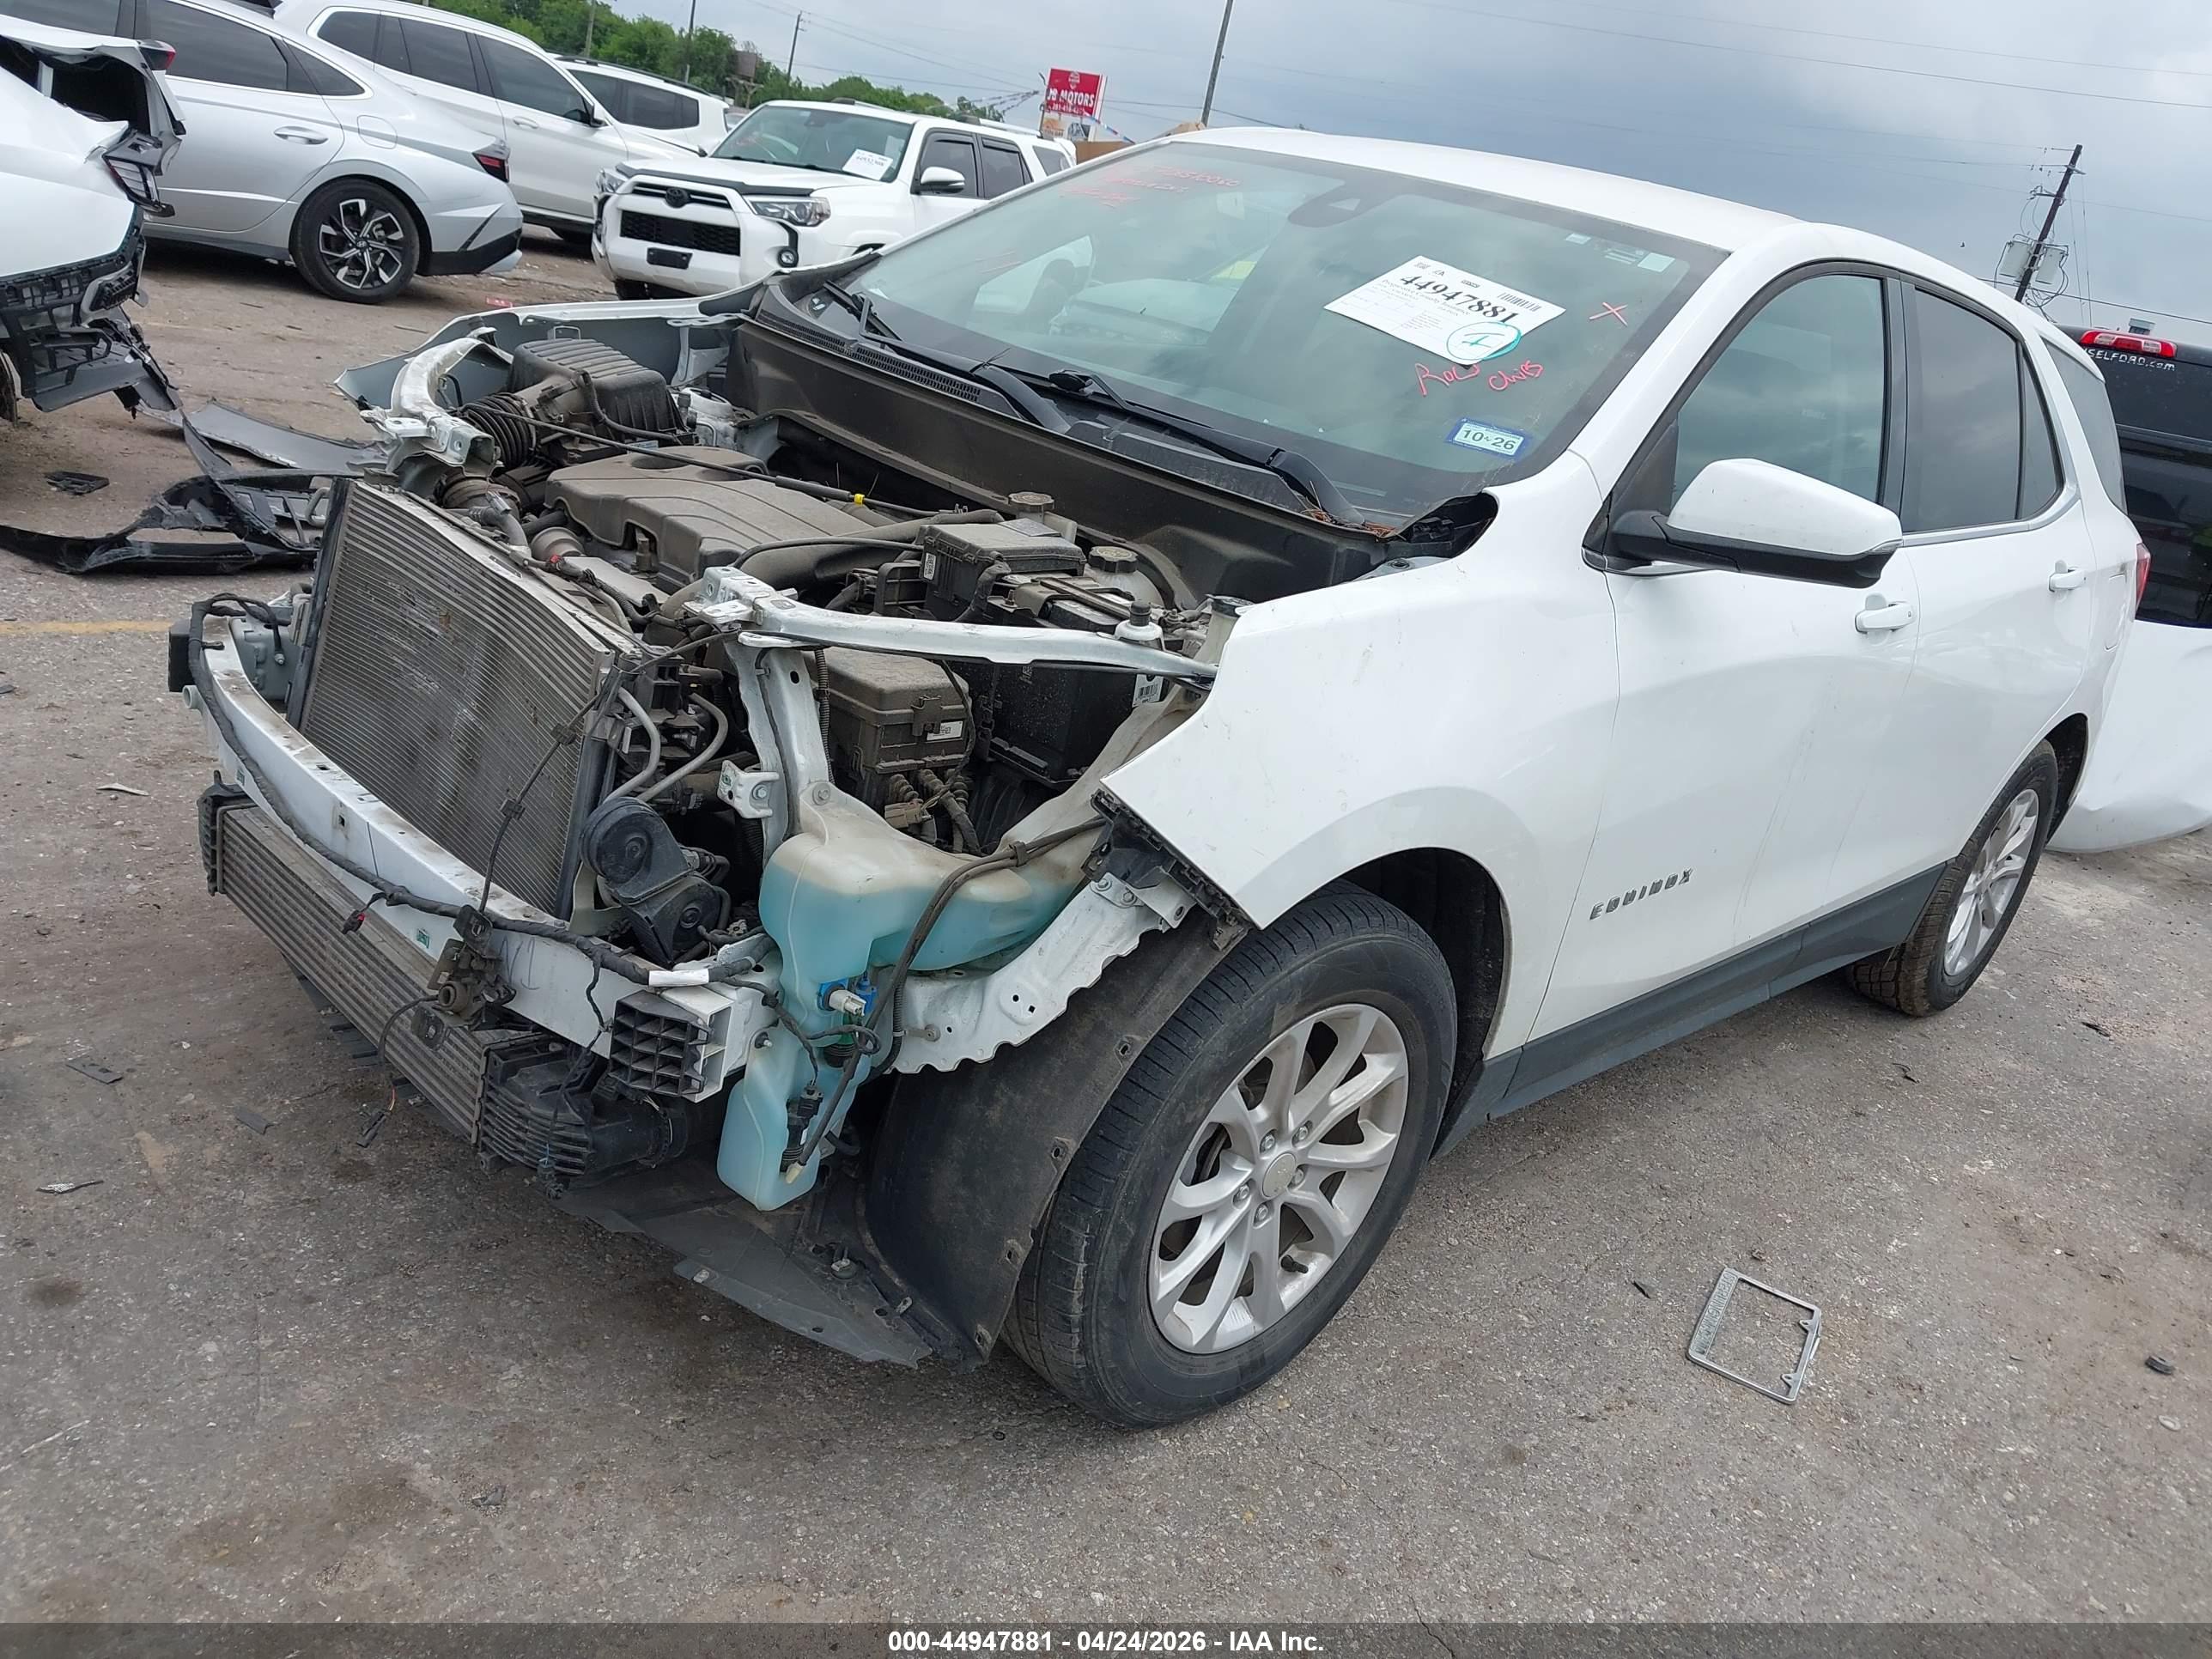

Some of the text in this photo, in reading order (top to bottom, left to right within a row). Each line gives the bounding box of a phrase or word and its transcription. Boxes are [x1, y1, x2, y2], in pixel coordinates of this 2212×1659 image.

[1059, 88, 1095, 107] MOTORS
[1400, 275, 1519, 323] 44947881
[1589, 867, 1694, 921] EQUINOX
